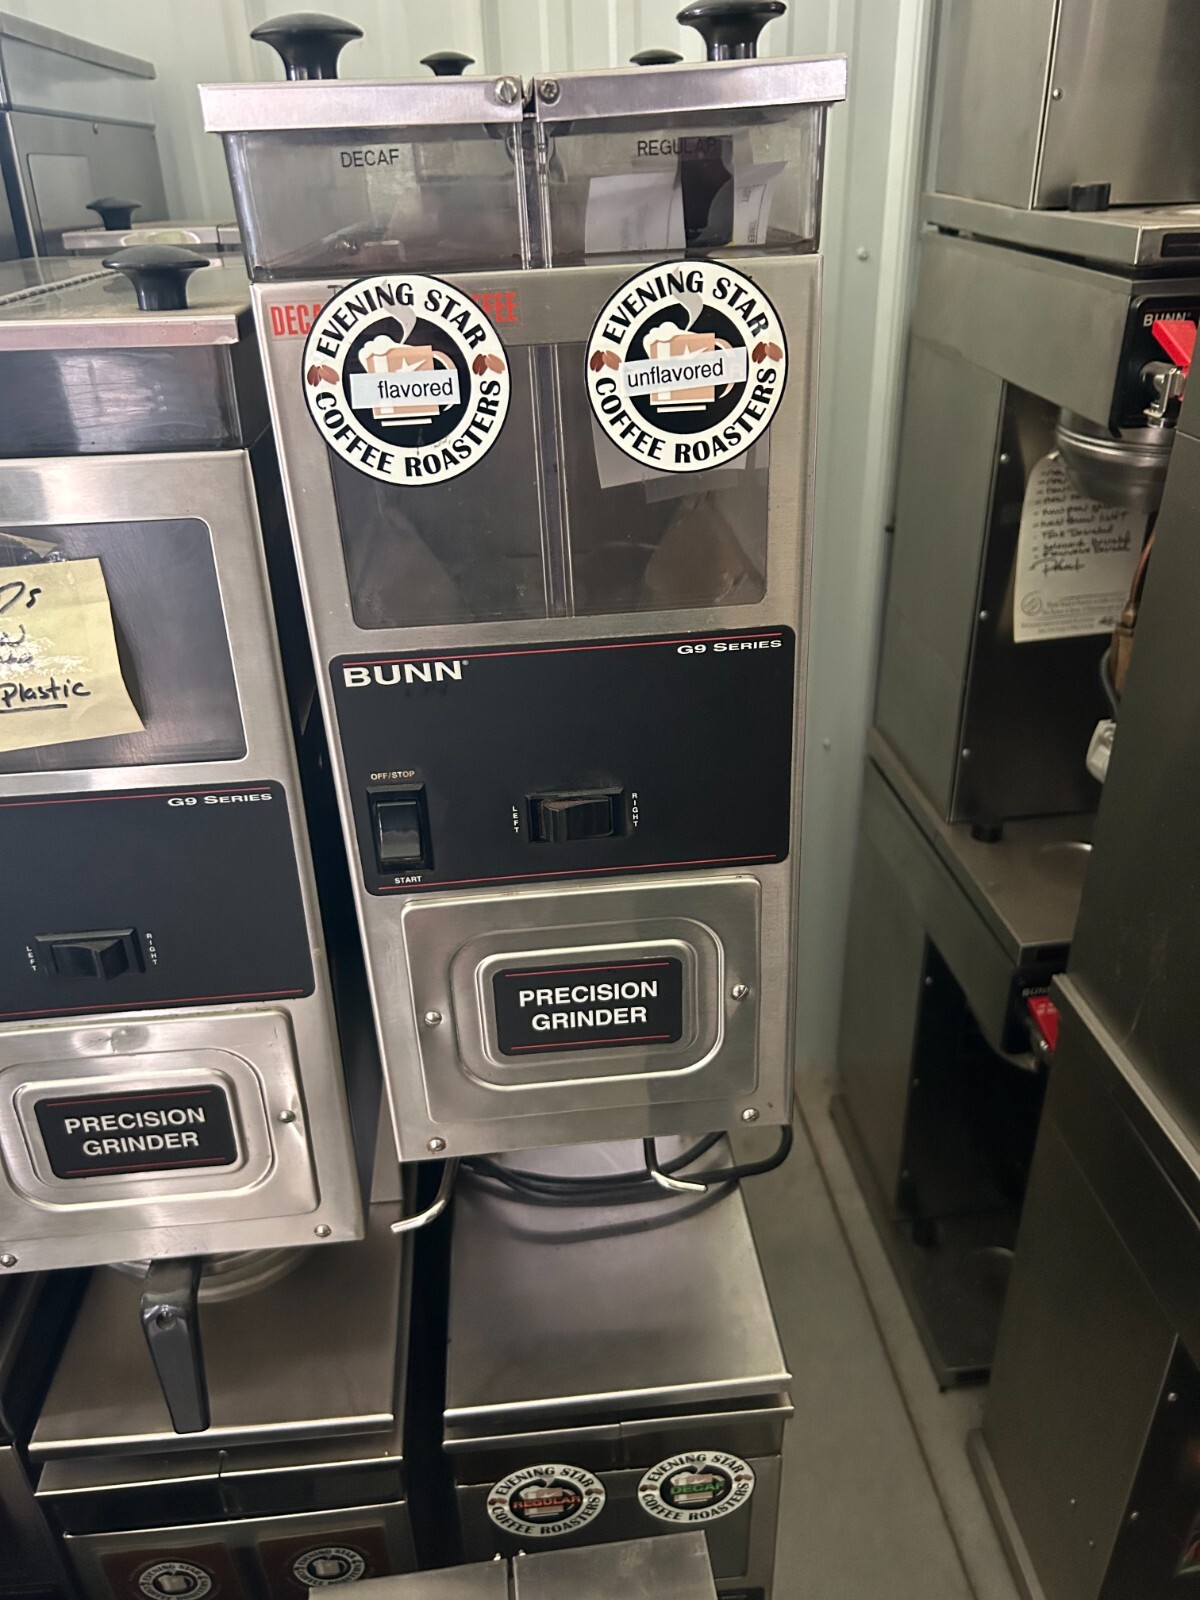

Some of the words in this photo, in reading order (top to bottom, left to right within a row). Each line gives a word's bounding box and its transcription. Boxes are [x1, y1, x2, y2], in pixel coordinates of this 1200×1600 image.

[340, 149, 399, 168] DECAF
[637, 137, 717, 157] REGULAR
[316, 283, 414, 358] EVENING
[424, 289, 487, 350] STAR
[471, 291, 519, 323] FEE
[602, 270, 704, 345] EVENING
[712, 277, 769, 338] STAR
[627, 358, 724, 388] unflavored
[377, 378, 453, 399] flavored
[316, 391, 395, 475] COFFEE
[405, 380, 500, 477] ROASTERS
[595, 377, 666, 460] COFFEE
[674, 368, 777, 464] ROASTERS
[677, 644, 707, 655] G9
[713, 639, 782, 652] SERIES
[370, 770, 415, 780] OFF/STOP
[167, 797, 197, 806] G9
[204, 792, 272, 805] SERIES
[631, 792, 639, 827] RIGHT
[512, 805, 520, 833] LEFT
[394, 875, 422, 885] START
[26, 945, 37, 972] LEFT
[519, 980, 658, 1007] PRECISION
[531, 1006, 647, 1031] GRINDER
[64, 1106, 206, 1135] PRECISION
[82, 1131, 200, 1157] GRINDER
[496, 1466, 555, 1496] EVENING
[560, 1467, 595, 1487] STAR
[647, 1453, 707, 1482] EVENING
[711, 1454, 745, 1474] STAR
[492, 1506, 535, 1534] COFFEE
[540, 1496, 600, 1535] ROASTERS
[512, 1495, 582, 1509] REGULAR
[642, 1493, 684, 1520] COFFEE
[688, 1482, 750, 1521] ROASTERS
